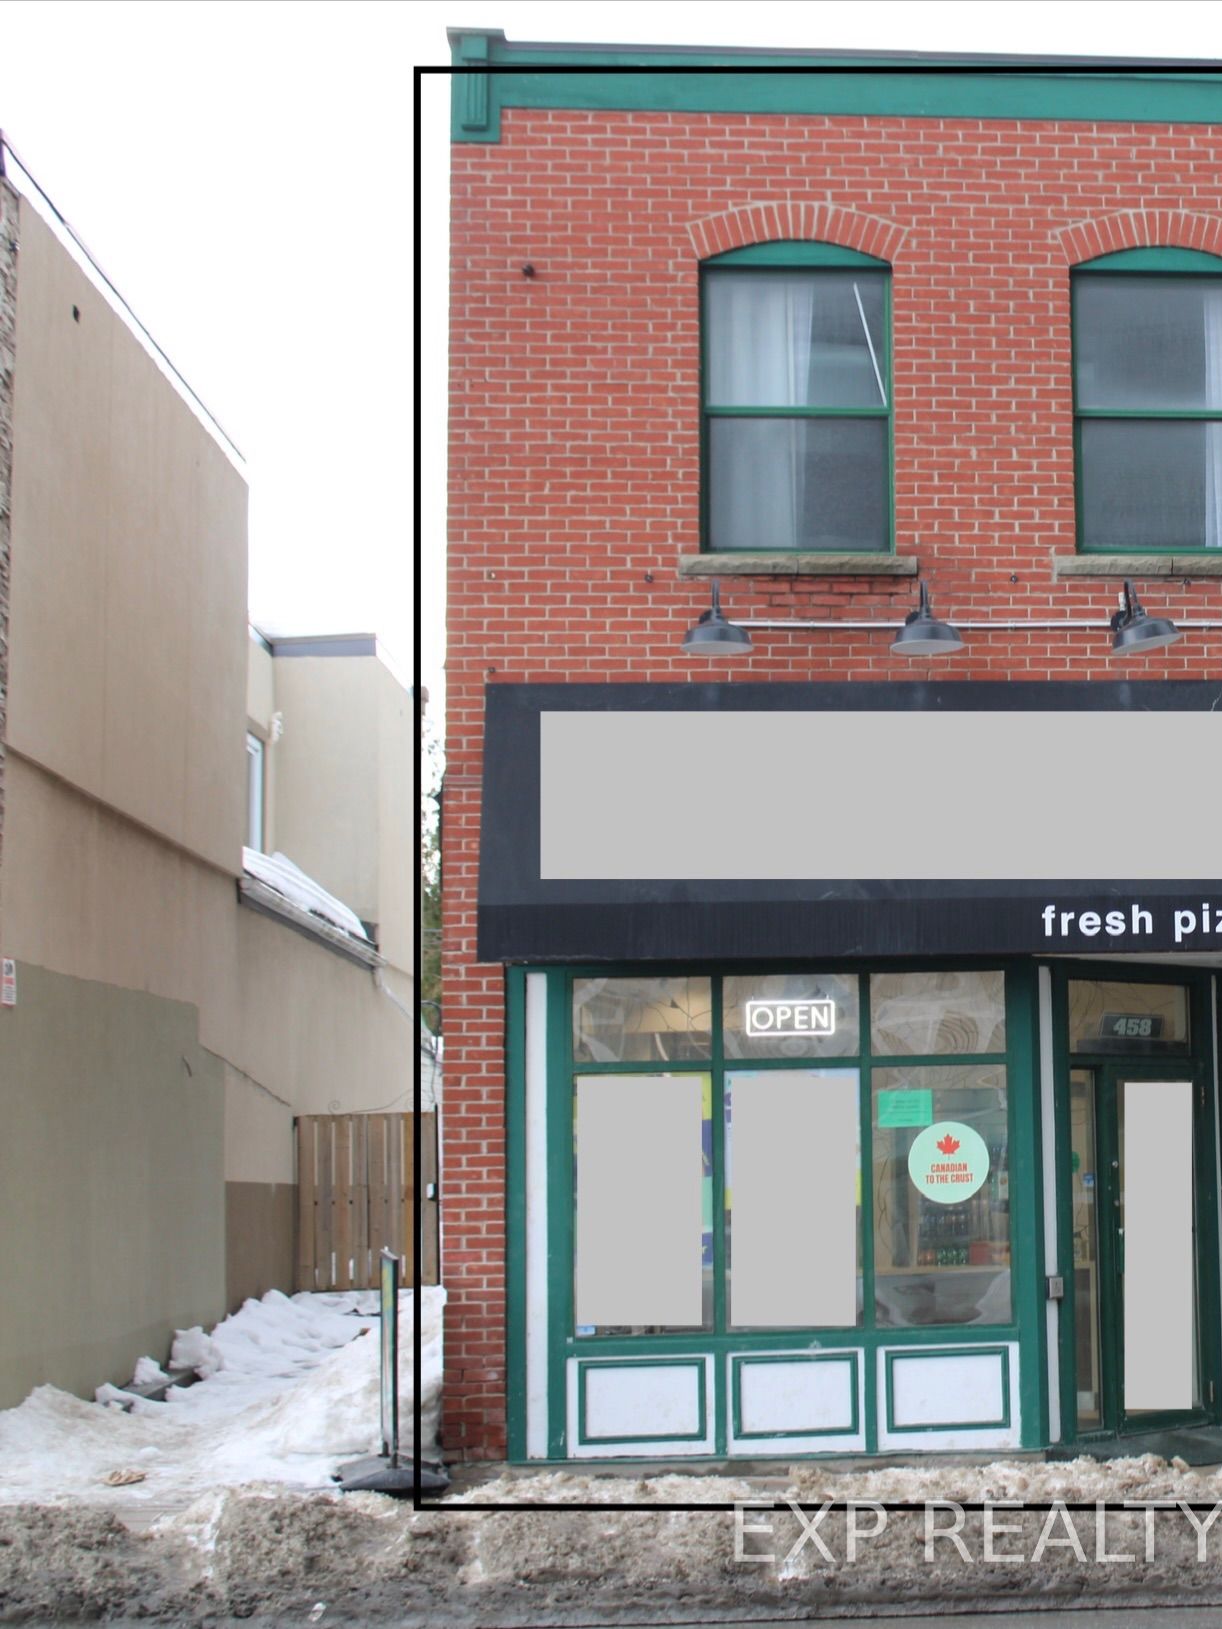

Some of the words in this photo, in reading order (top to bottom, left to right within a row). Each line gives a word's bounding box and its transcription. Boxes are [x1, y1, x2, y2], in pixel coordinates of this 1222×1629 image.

[1041, 904, 1154, 937] fresh
[751, 1005, 829, 1030] OPEN
[1112, 1018, 1153, 1036] 458
[930, 1163, 968, 1173] CANADIAN
[925, 1174, 935, 1185] TO
[936, 1174, 949, 1184] THE
[951, 1173, 973, 1184] CRUST
